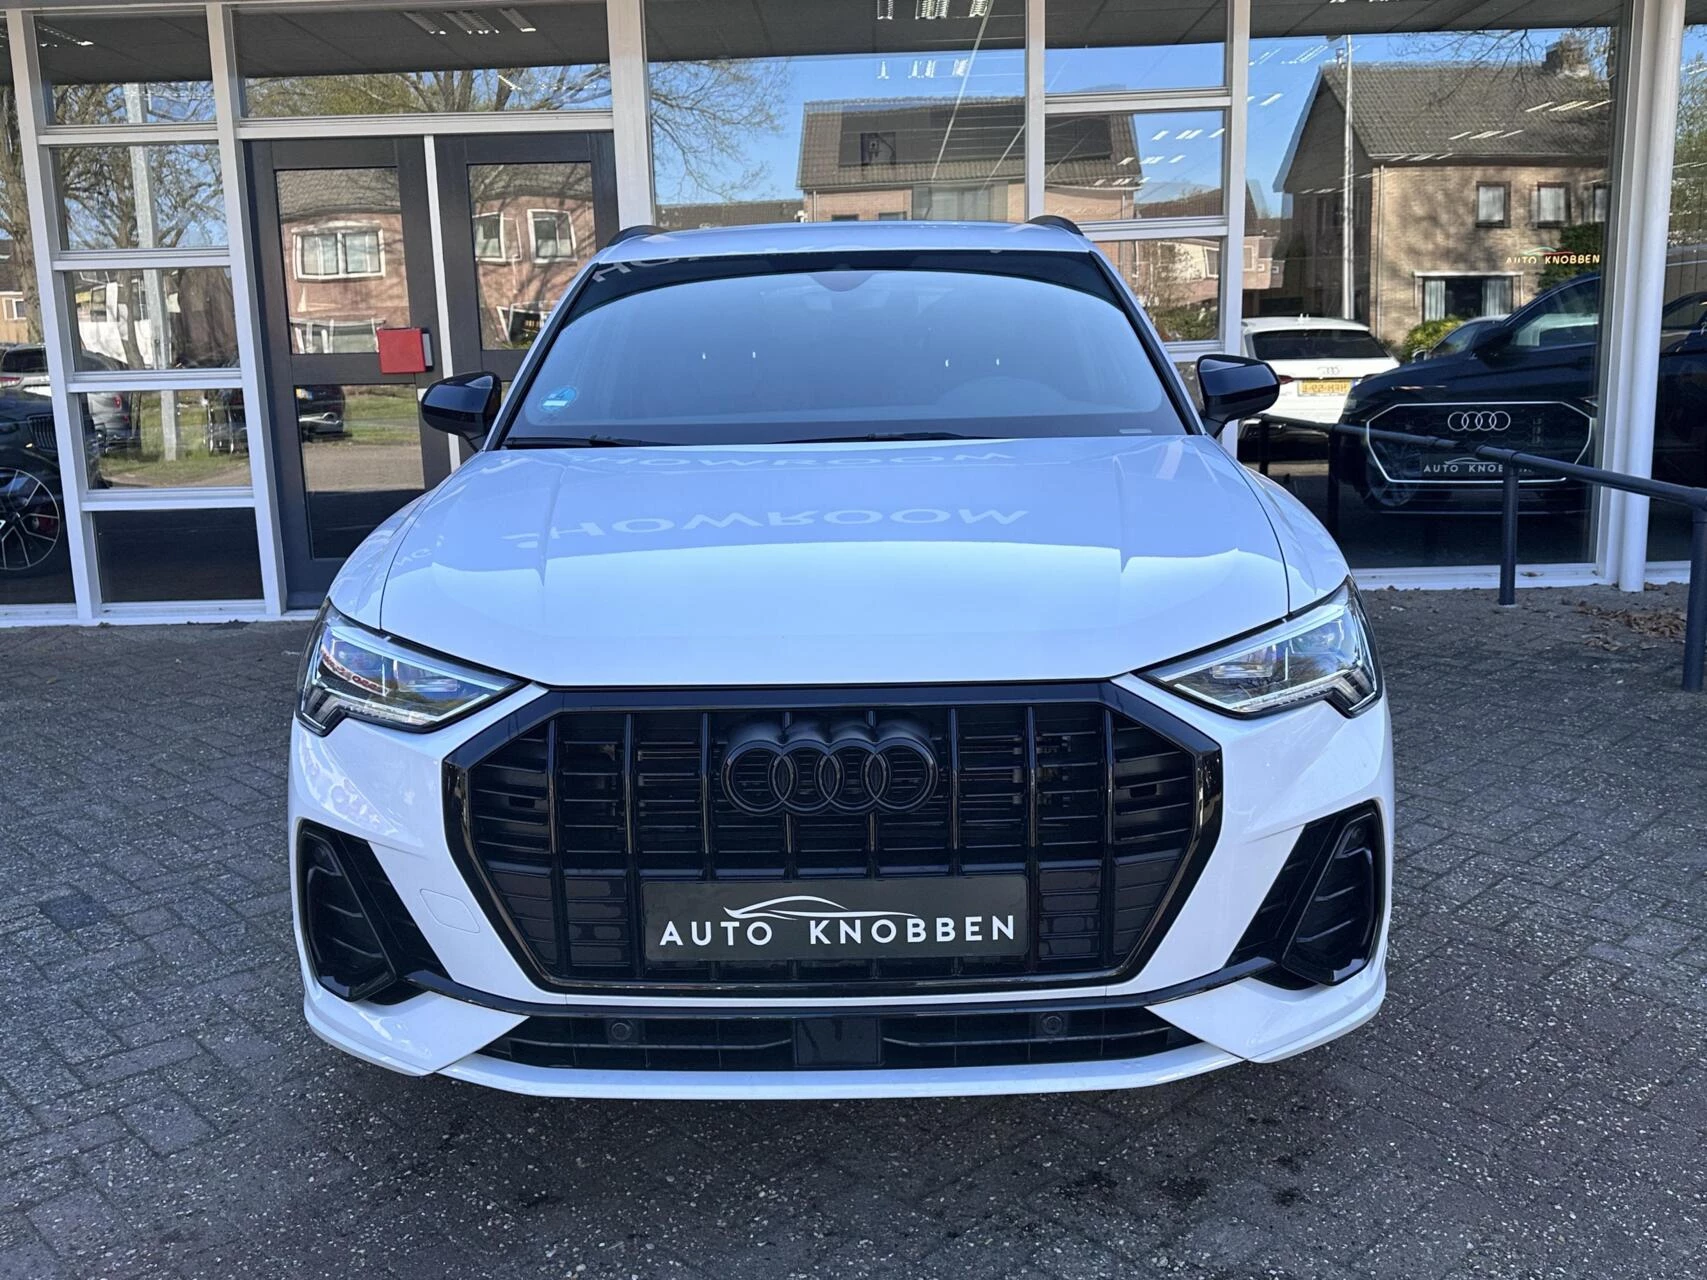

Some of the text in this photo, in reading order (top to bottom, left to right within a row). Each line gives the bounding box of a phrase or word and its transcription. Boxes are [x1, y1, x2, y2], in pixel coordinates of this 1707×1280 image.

[1505, 254, 1600, 265] AUTO KNOBBEN
[570, 452, 1017, 466] SHOWROOM
[1423, 464, 1459, 473] AUTO
[659, 914, 1016, 947] AUTO KNOBBEN
